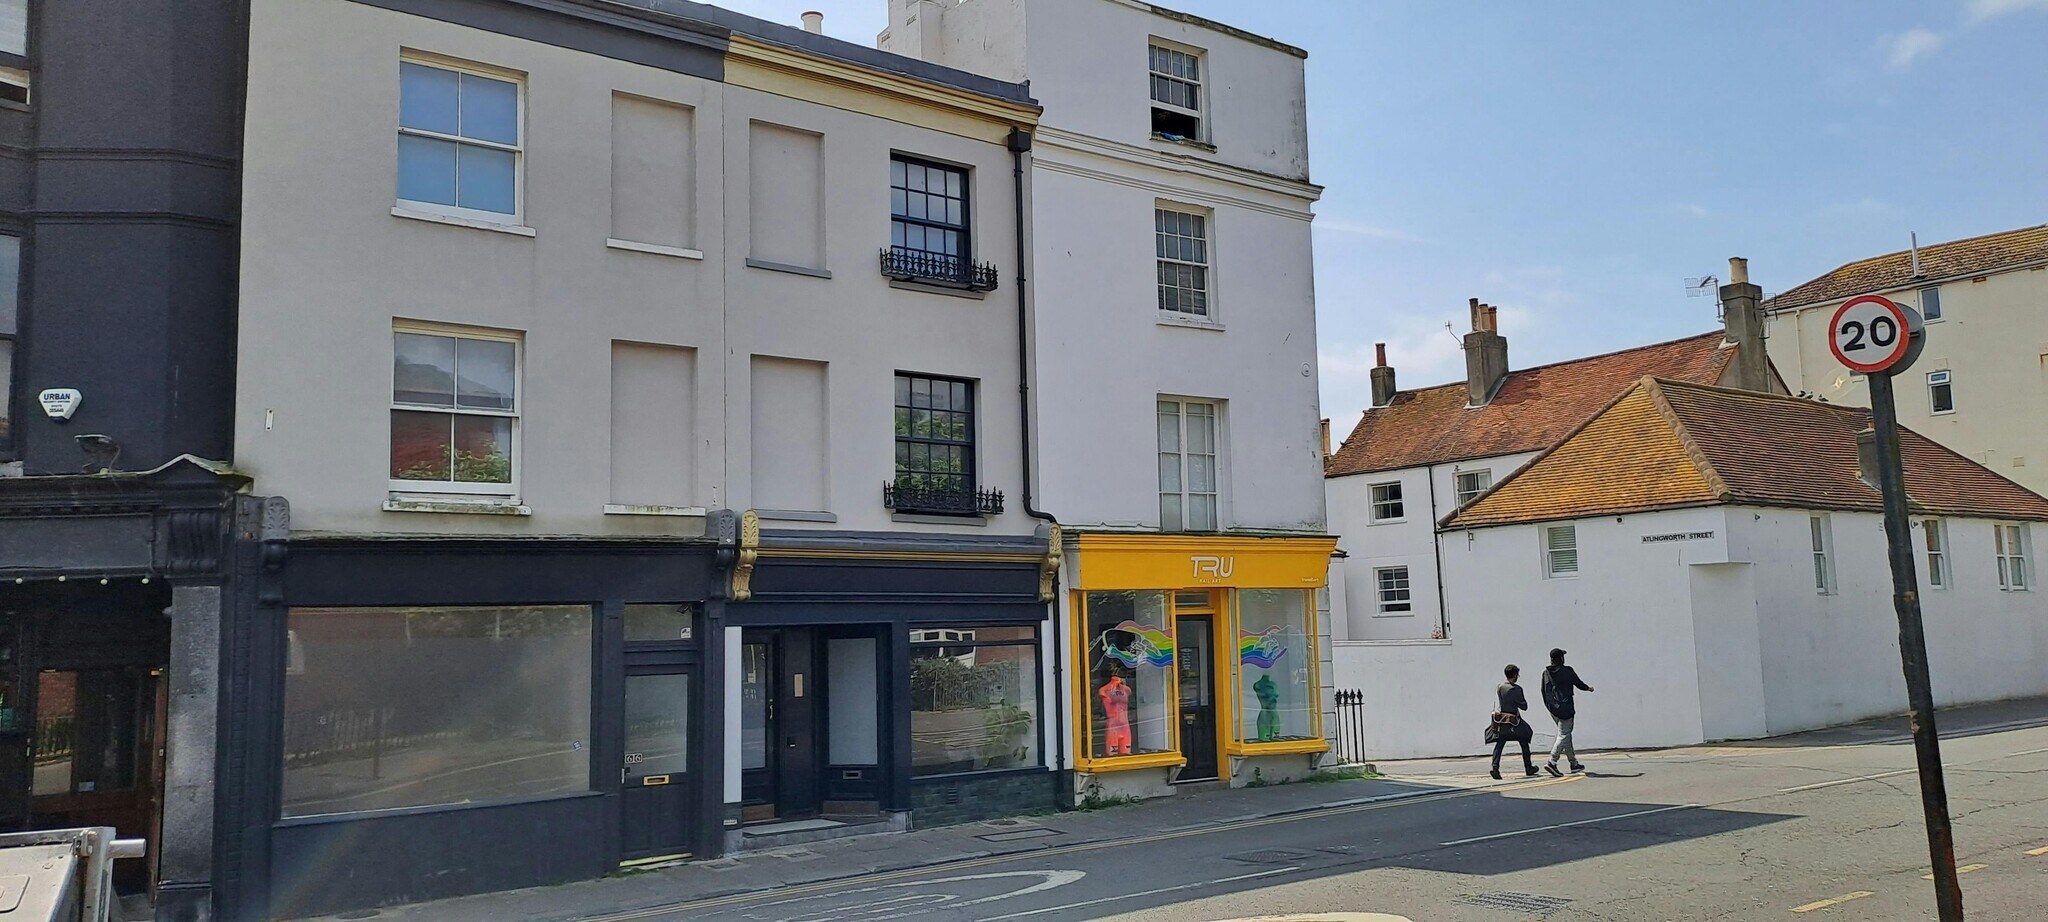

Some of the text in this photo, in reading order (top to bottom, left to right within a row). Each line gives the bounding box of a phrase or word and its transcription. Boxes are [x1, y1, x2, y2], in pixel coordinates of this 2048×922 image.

[1841, 316, 1897, 352] 20
[1642, 531, 1712, 542] ATLINGWORTH STREET
[1191, 556, 1234, 578] TRU
[626, 754, 641, 762] 66
